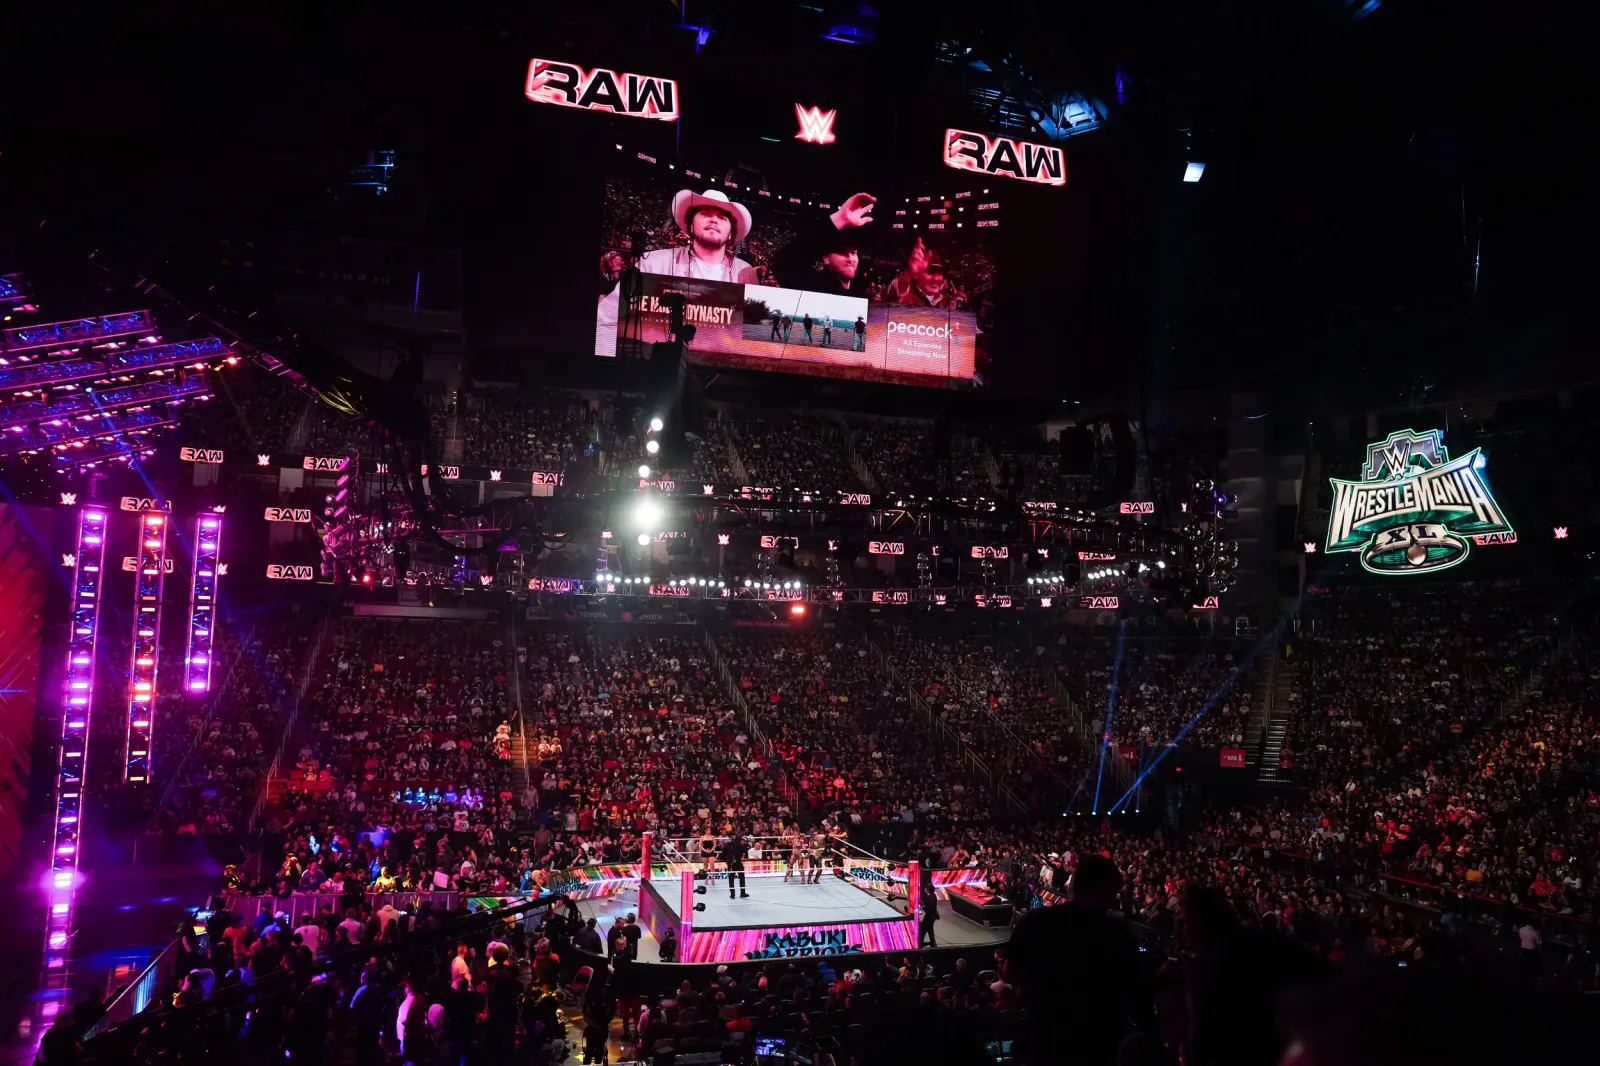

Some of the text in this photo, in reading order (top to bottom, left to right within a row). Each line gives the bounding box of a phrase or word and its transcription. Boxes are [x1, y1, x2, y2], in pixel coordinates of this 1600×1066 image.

[527, 59, 678, 120] RAW
[945, 129, 1065, 185] RAW
[685, 303, 733, 325] DYNASTY
[887, 321, 953, 339] peacock
[897, 348, 931, 359] Streaming
[913, 341, 942, 350] Episodes
[180, 447, 223, 463] RAW
[264, 507, 311, 522] RAW
[1120, 502, 1154, 514] RAW
[1386, 523, 1438, 544] XL
[869, 541, 904, 554] RAW
[266, 564, 313, 580] RAW
[579, 611, 608, 619] TOYOTA
[764, 929, 846, 949] KABUKI
